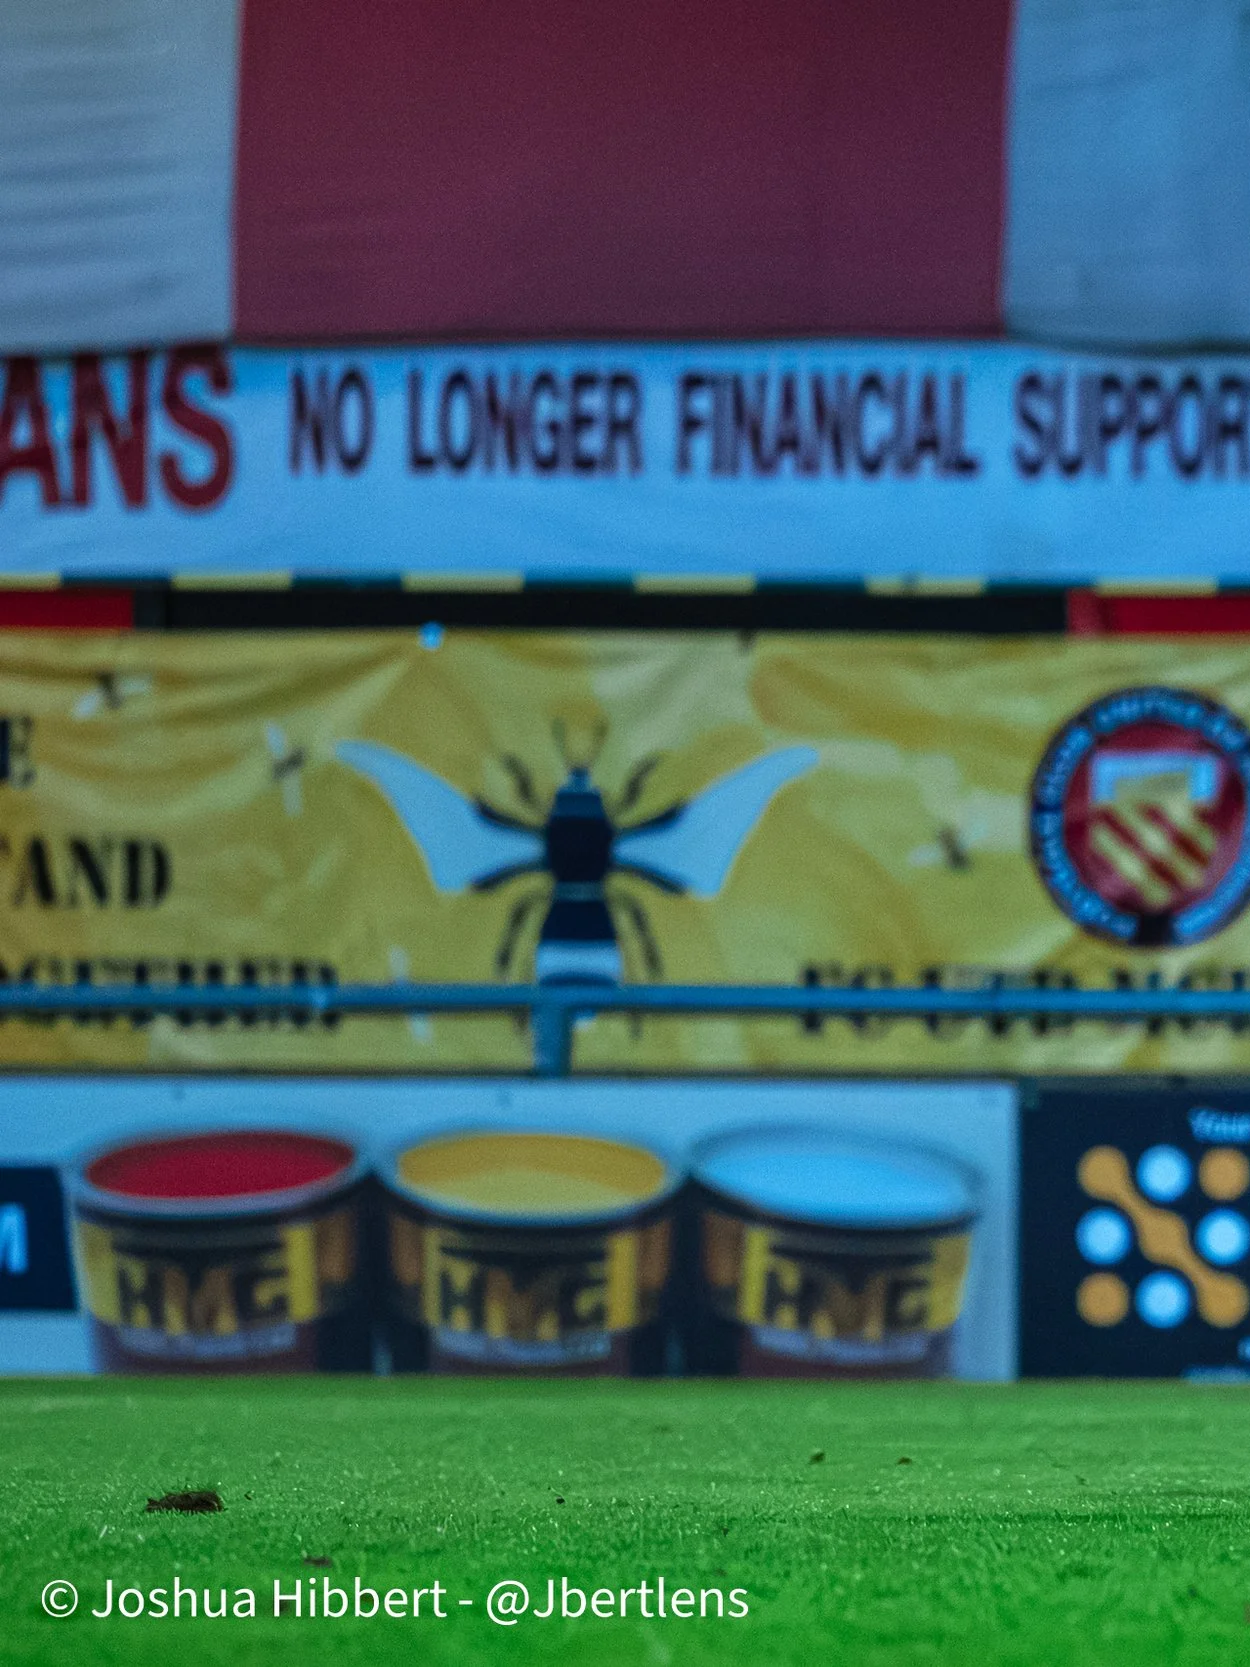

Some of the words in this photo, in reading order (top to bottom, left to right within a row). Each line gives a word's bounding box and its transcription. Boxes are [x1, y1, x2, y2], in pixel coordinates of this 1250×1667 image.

[288, 366, 375, 477] NO
[405, 366, 643, 477] LONGER
[674, 371, 982, 481] FINANCIAL
[0, 836, 173, 909] AND
